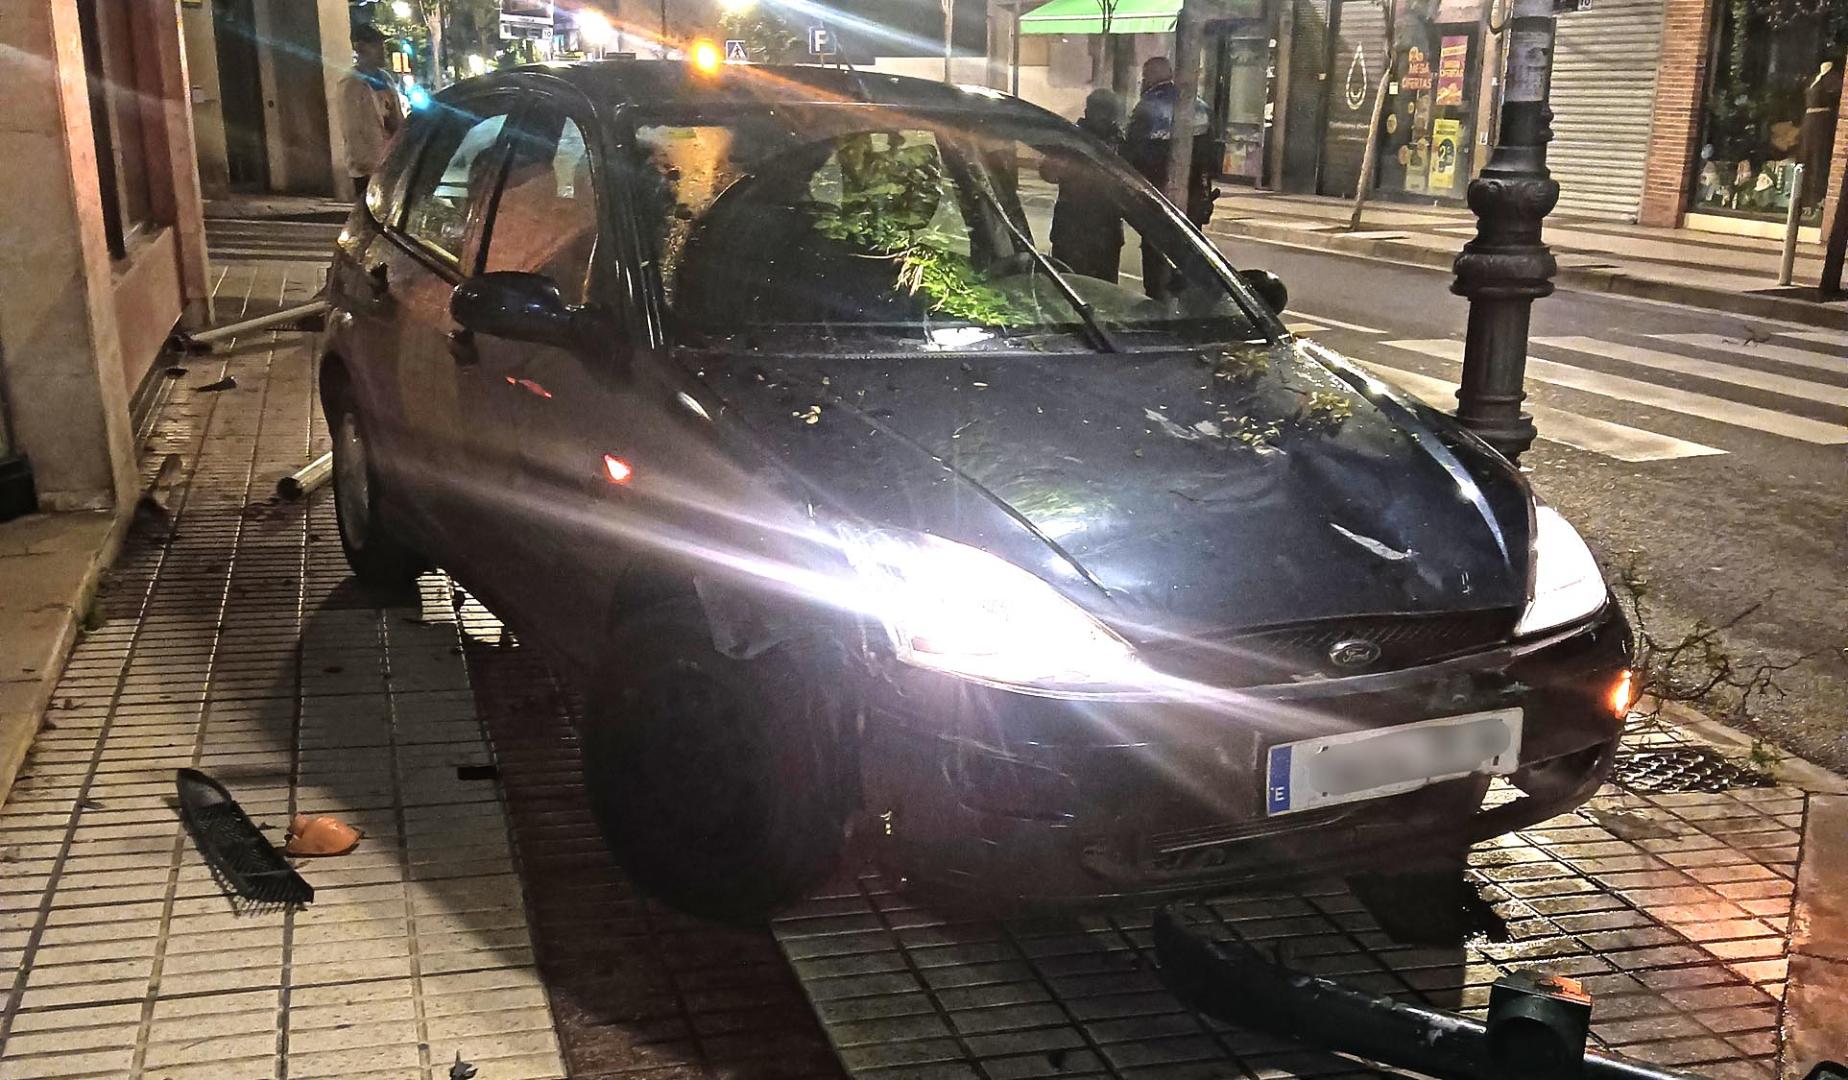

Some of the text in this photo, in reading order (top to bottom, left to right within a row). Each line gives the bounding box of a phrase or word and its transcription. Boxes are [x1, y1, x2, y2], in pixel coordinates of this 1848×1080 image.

[814, 30, 827, 52] F
[1402, 77, 1432, 89] OFERTAS
[1275, 786, 1285, 801] E
